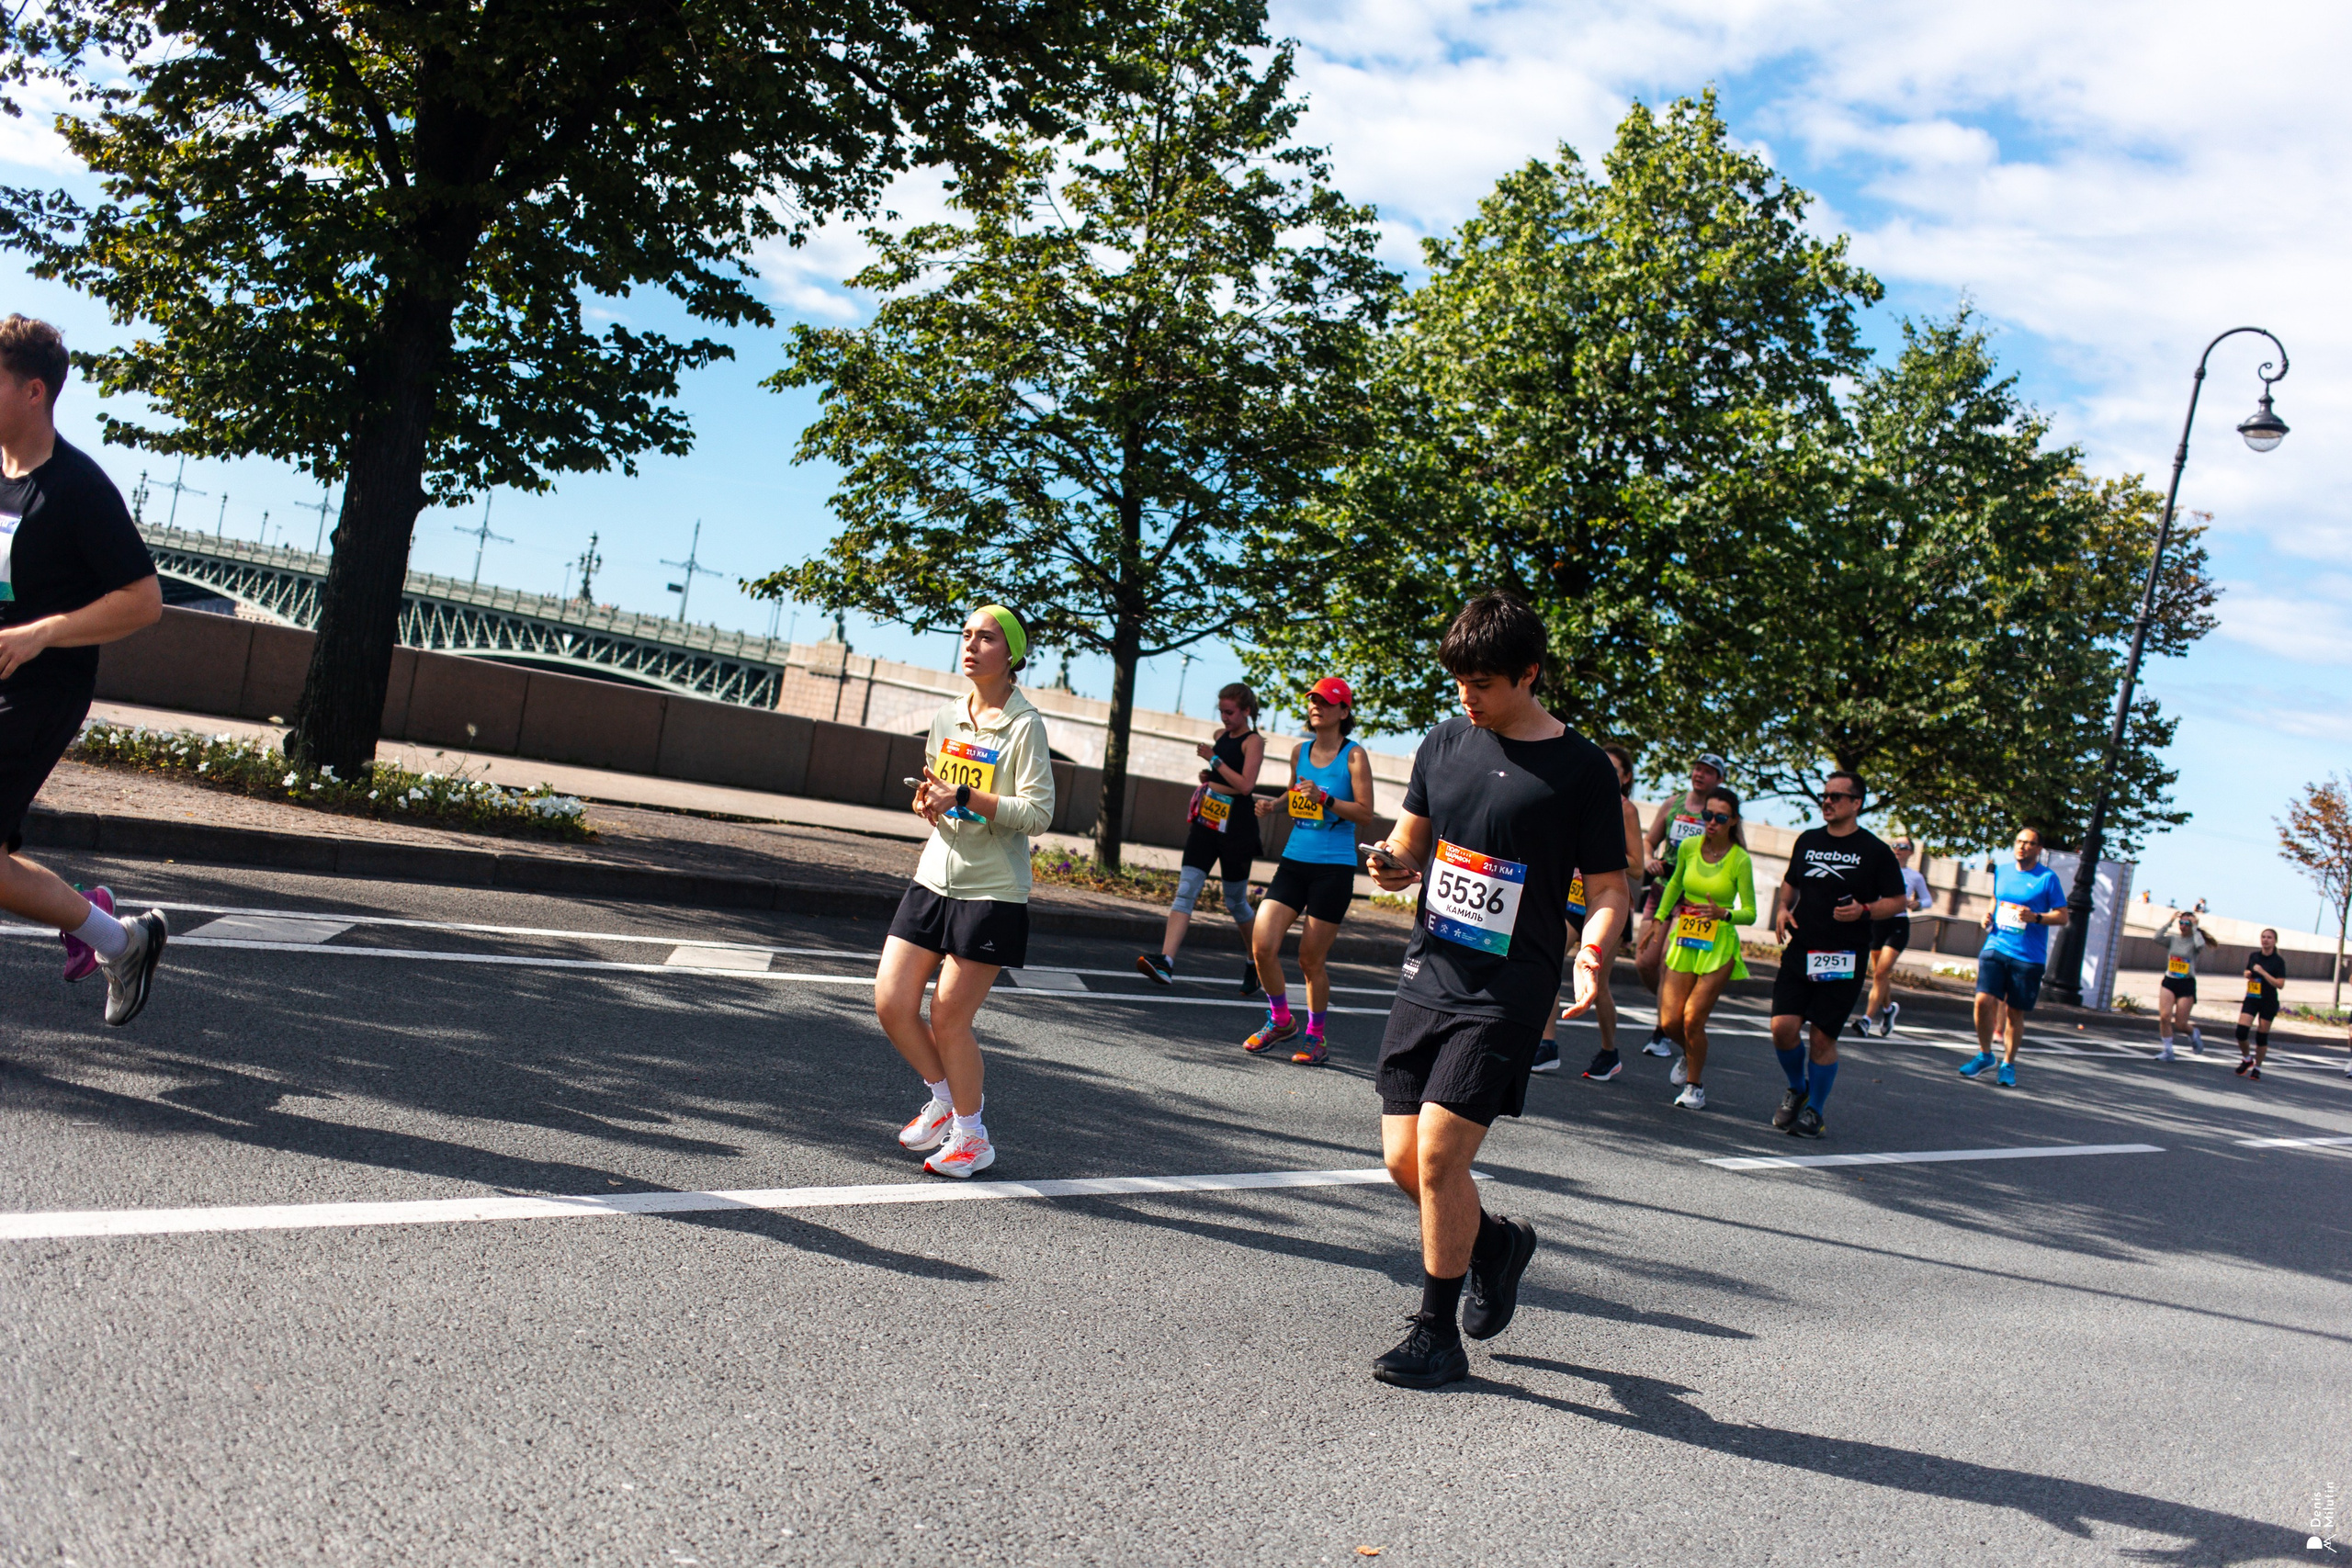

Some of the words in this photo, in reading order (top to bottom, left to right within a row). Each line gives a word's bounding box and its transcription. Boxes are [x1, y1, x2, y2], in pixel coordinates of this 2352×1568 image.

[939, 760, 983, 790] 6103
[1804, 849, 1861, 865] Reebok
[1482, 862, 1498, 873] 21,1
[1437, 870, 1505, 915] 5536
[1445, 904, 1484, 922] КАМИЛЬ
[1681, 918, 1713, 934] 2919
[1814, 955, 1848, 968] 2951
